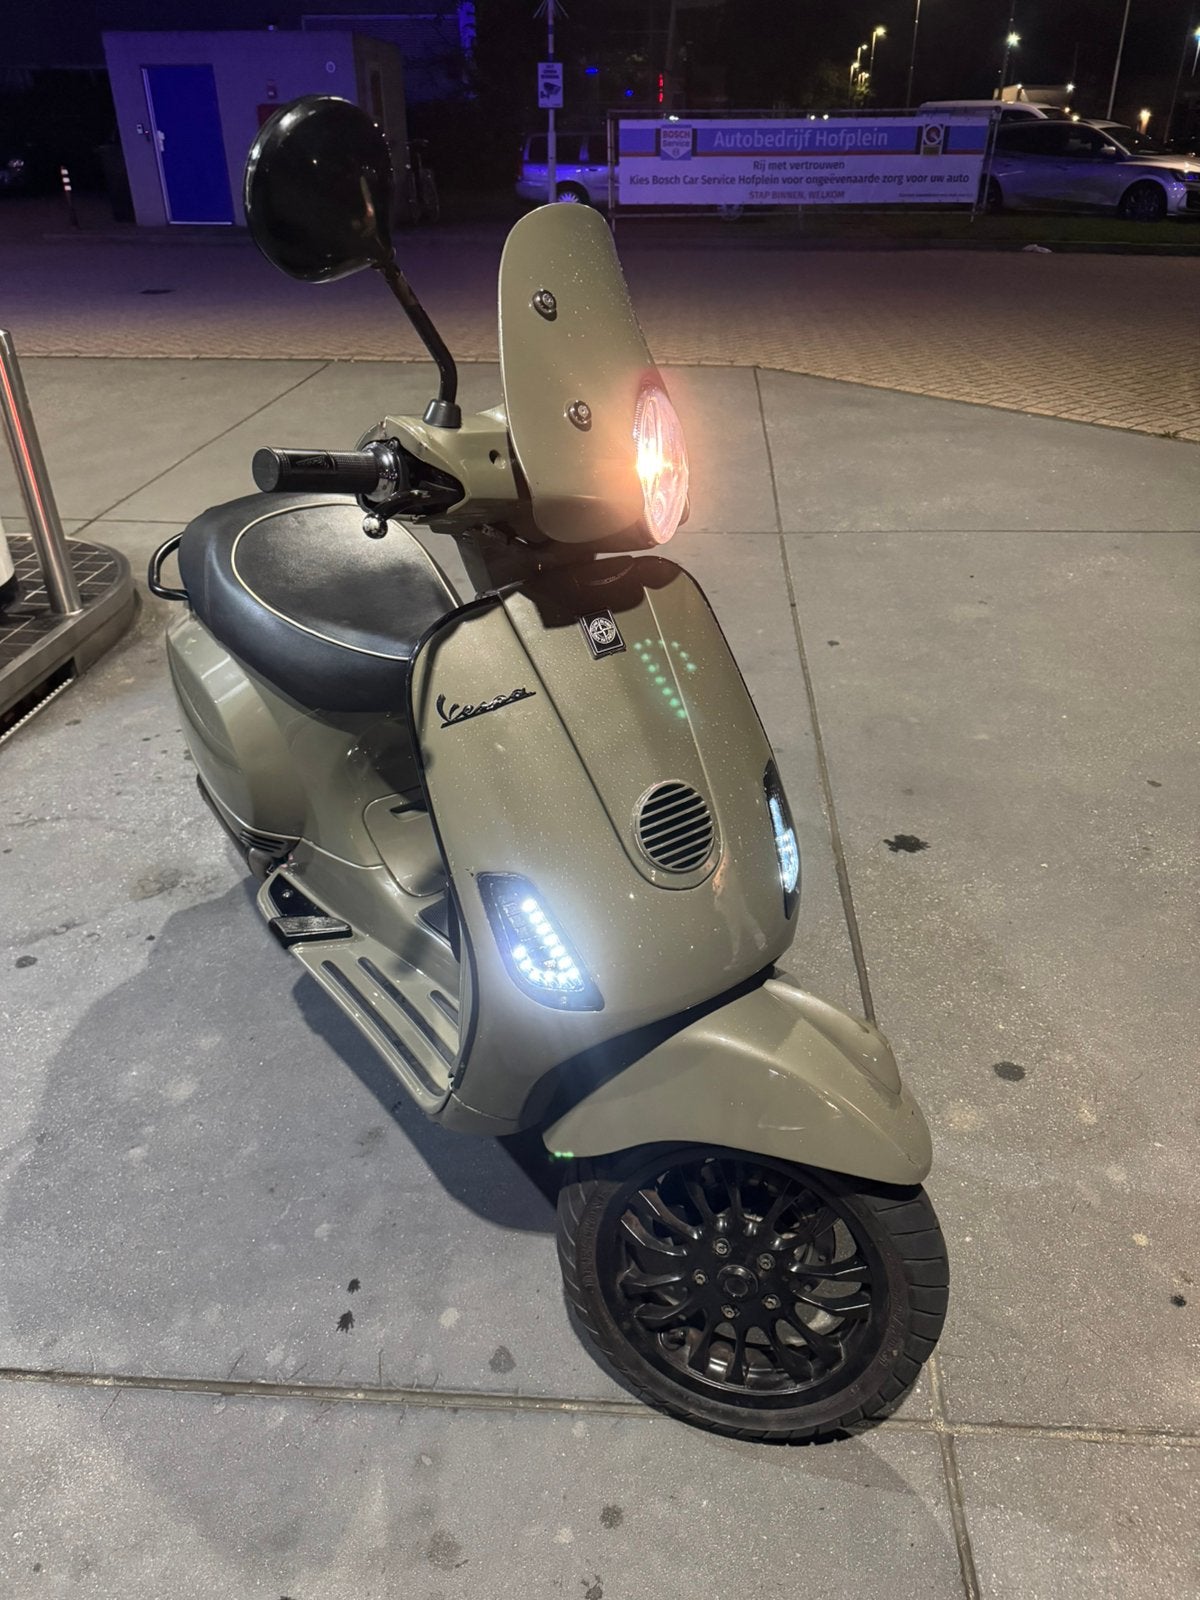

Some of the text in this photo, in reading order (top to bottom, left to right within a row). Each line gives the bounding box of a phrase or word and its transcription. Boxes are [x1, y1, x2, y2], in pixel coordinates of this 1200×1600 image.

[662, 130, 690, 139] BOSCH
[713, 127, 888, 150] Autobedrijf Hofplein
[753, 161, 845, 172] Rij met vertrouwen
[629, 173, 969, 186] Kies Bosch Car Service Hofplein voor ongeëvenaarde zorg voor uw auto
[749, 191, 769, 199] STAP
[808, 191, 845, 199] WELKOM
[436, 687, 537, 729] Vespa
